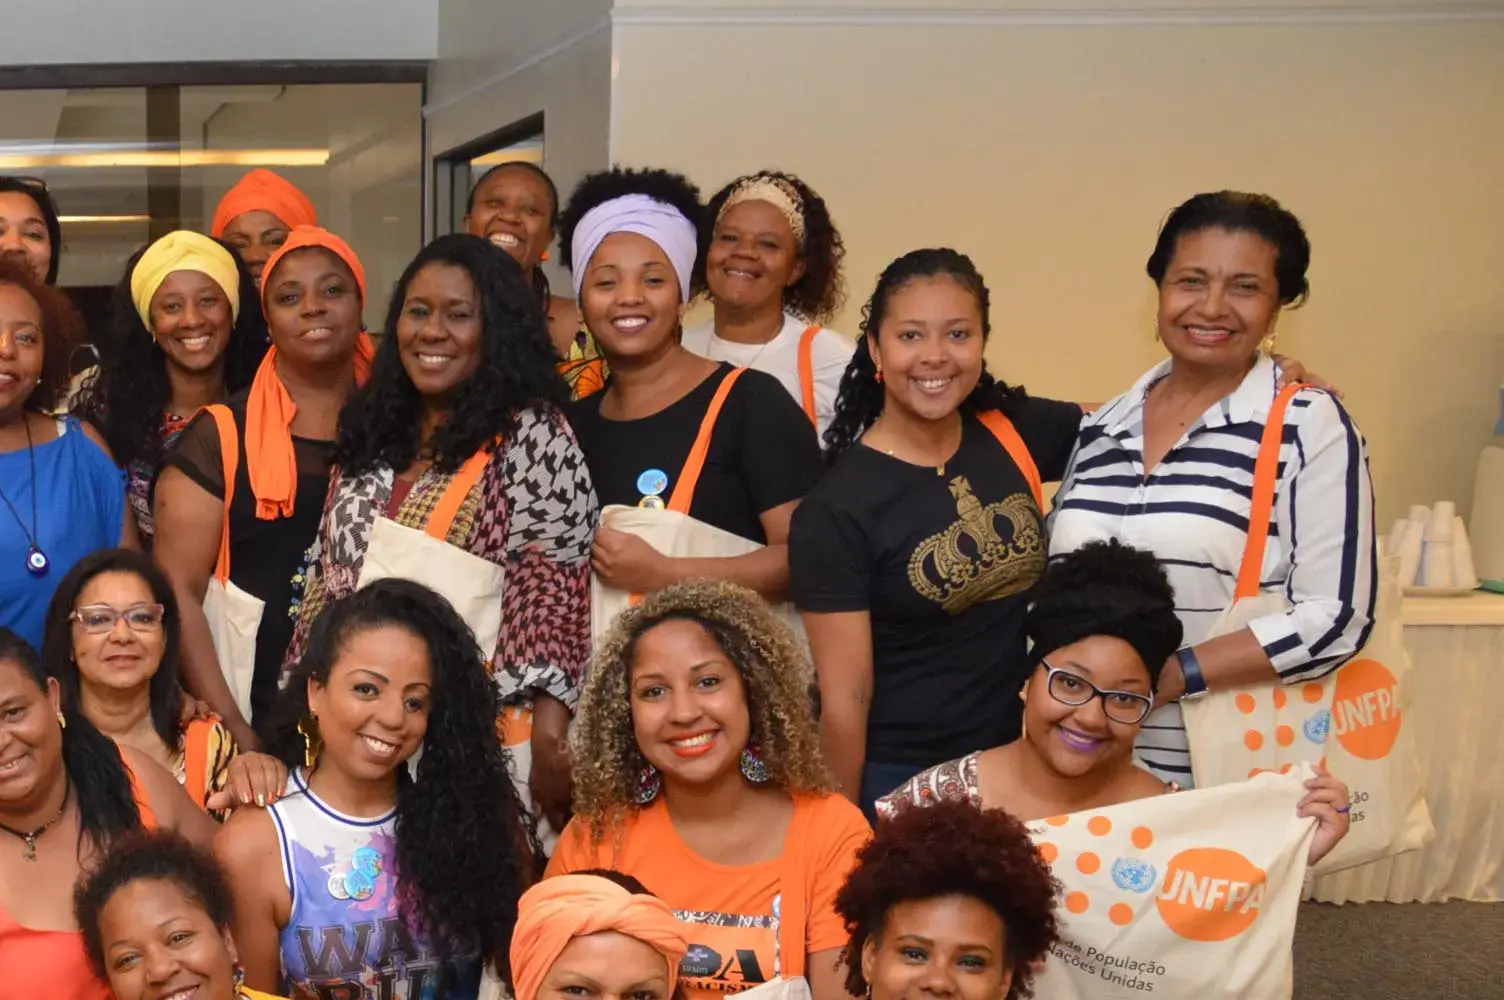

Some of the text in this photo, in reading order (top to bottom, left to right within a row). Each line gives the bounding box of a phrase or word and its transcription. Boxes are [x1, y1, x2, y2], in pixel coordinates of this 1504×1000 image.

[1159, 868, 1266, 914] UNFPA
[296, 916, 436, 977] WA
[1086, 946, 1166, 976] População
[1100, 967, 1154, 992] Unidas
